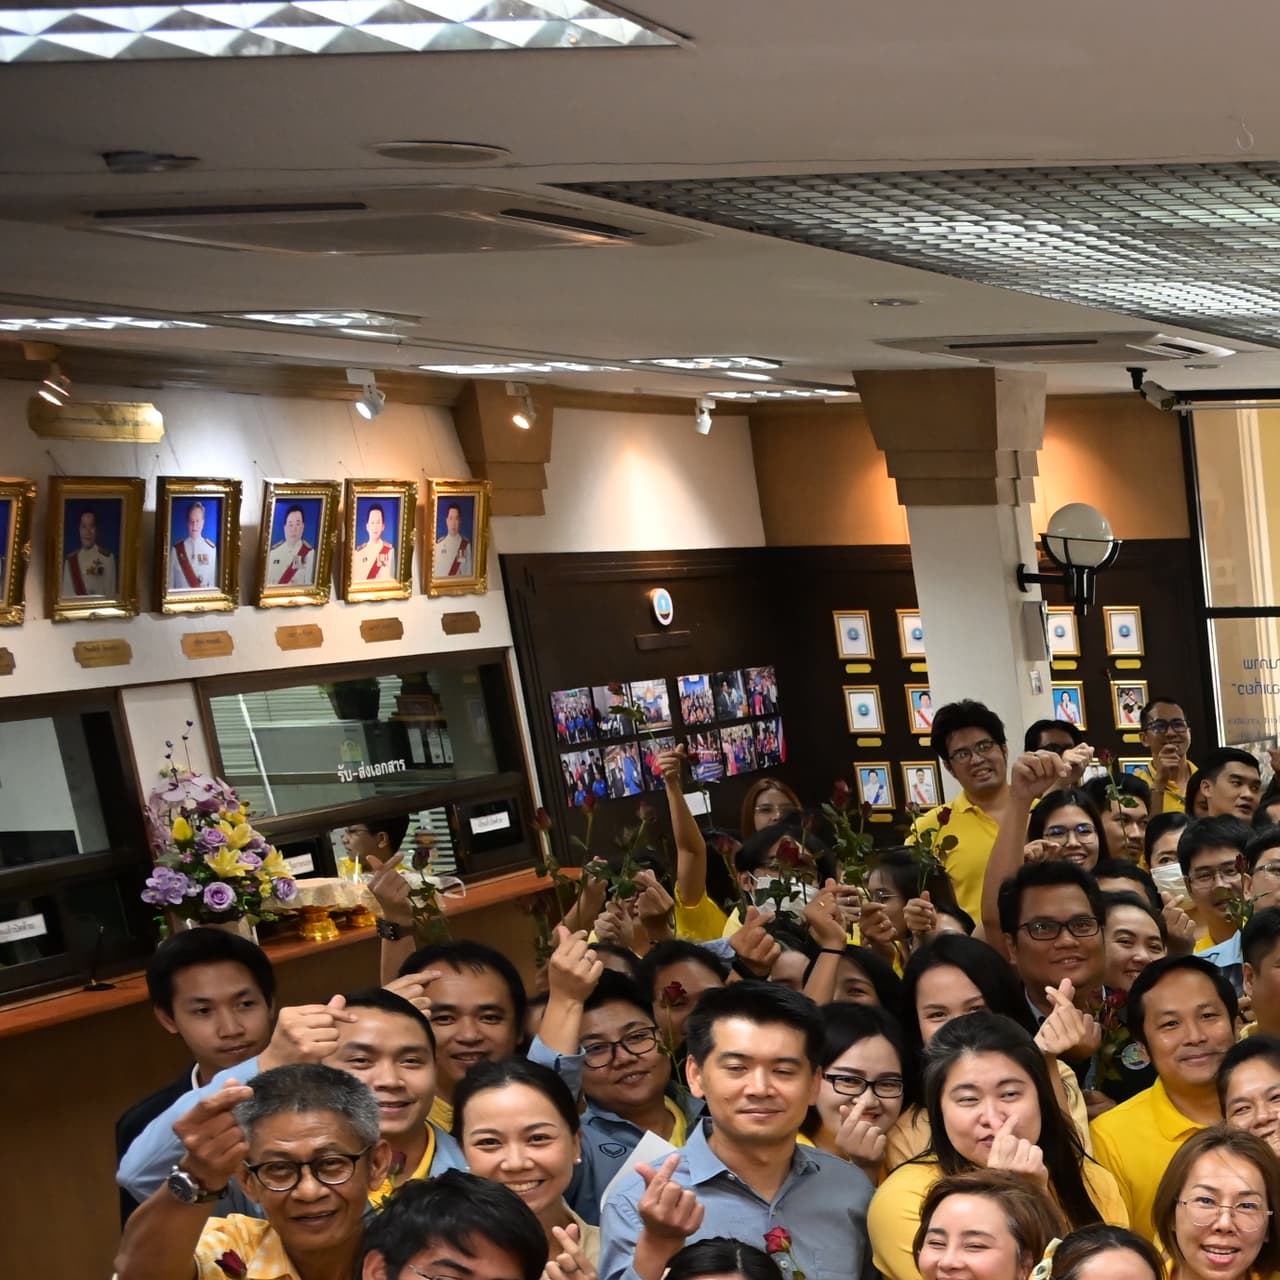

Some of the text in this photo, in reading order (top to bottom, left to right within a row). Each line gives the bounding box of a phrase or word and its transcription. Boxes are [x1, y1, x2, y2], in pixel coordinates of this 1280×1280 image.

[337, 759, 406, 783] รับ-ส่งเอกสาร
